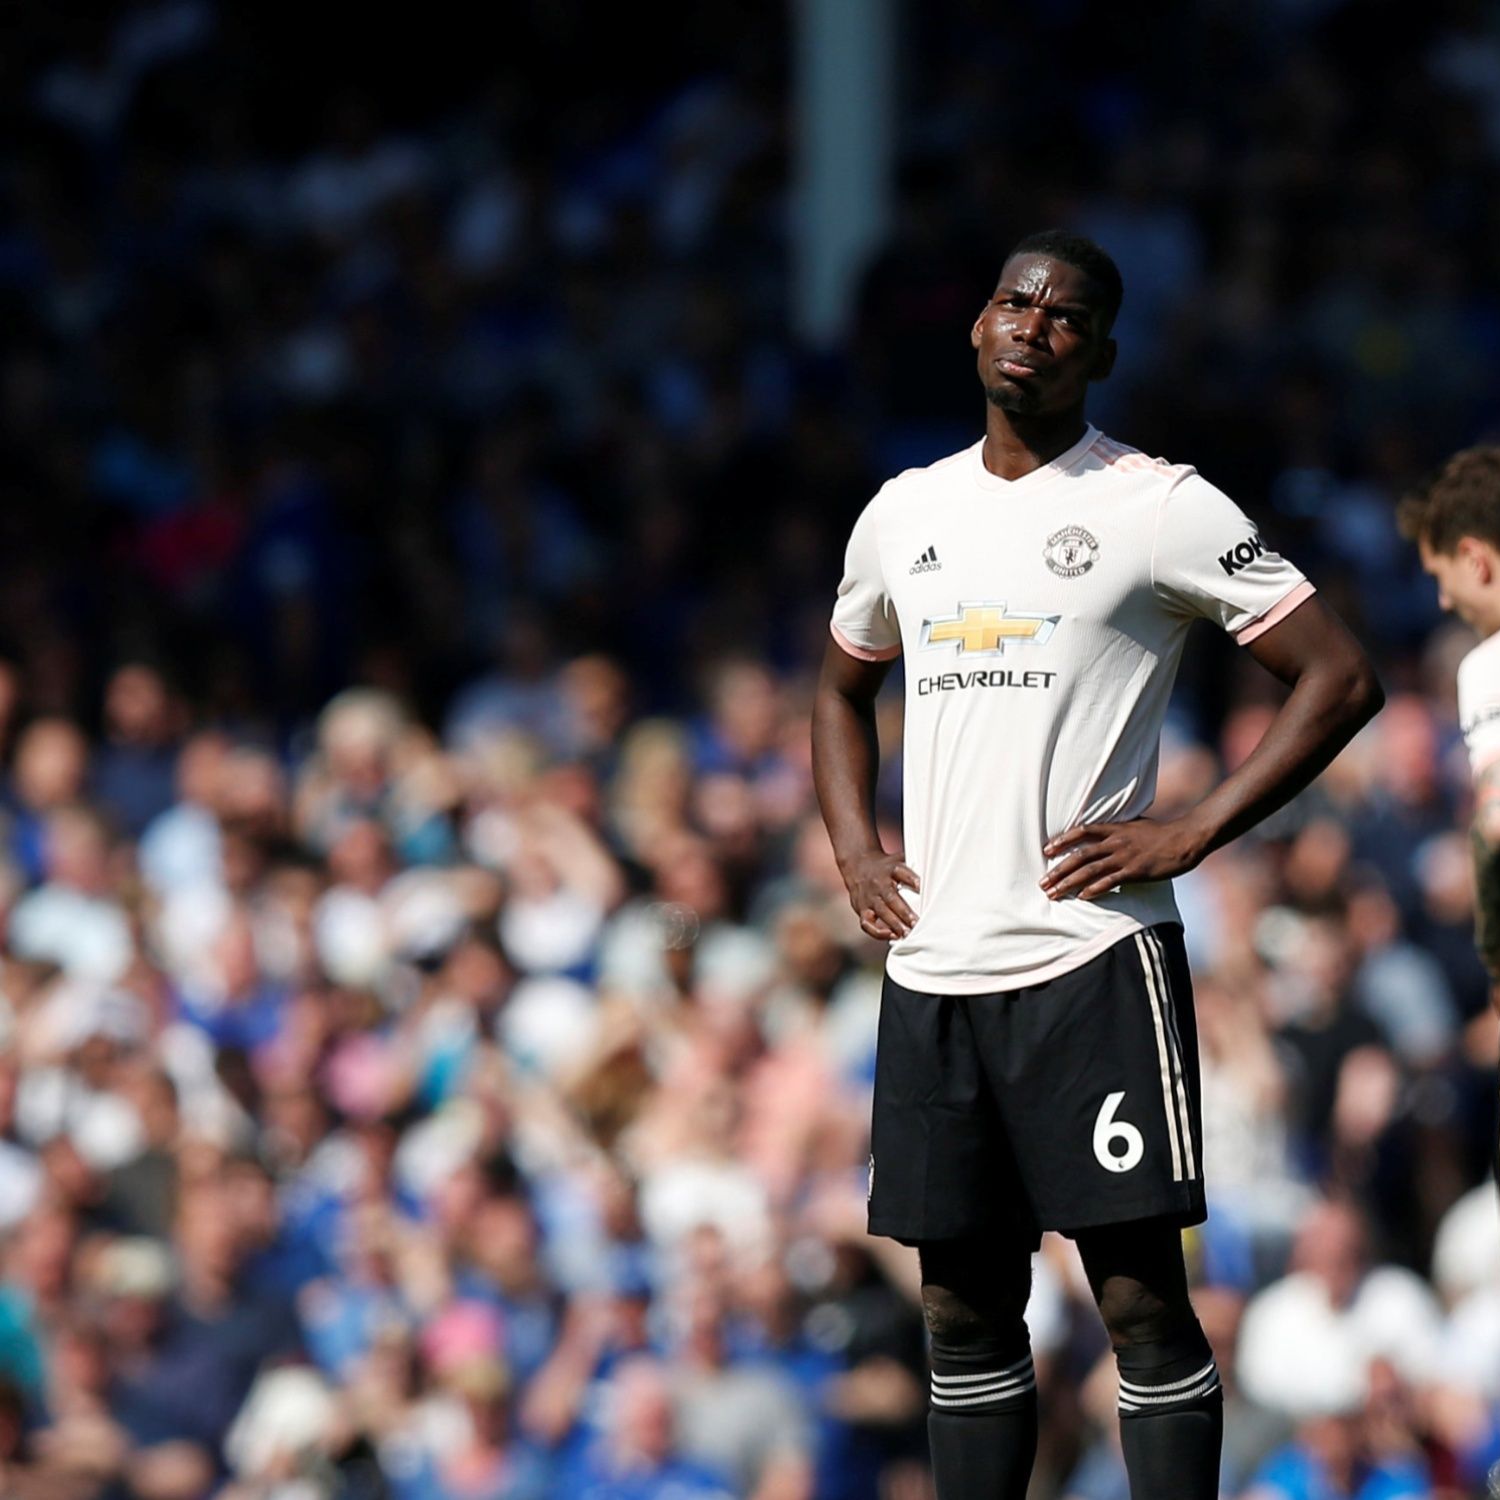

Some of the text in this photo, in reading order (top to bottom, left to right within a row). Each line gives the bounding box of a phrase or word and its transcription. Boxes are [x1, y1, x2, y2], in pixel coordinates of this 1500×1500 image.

[909, 561, 942, 575] adidas
[1053, 564, 1086, 577] UNITED
[918, 670, 1057, 696] CHEVROLET
[1092, 1090, 1145, 1173] 6
